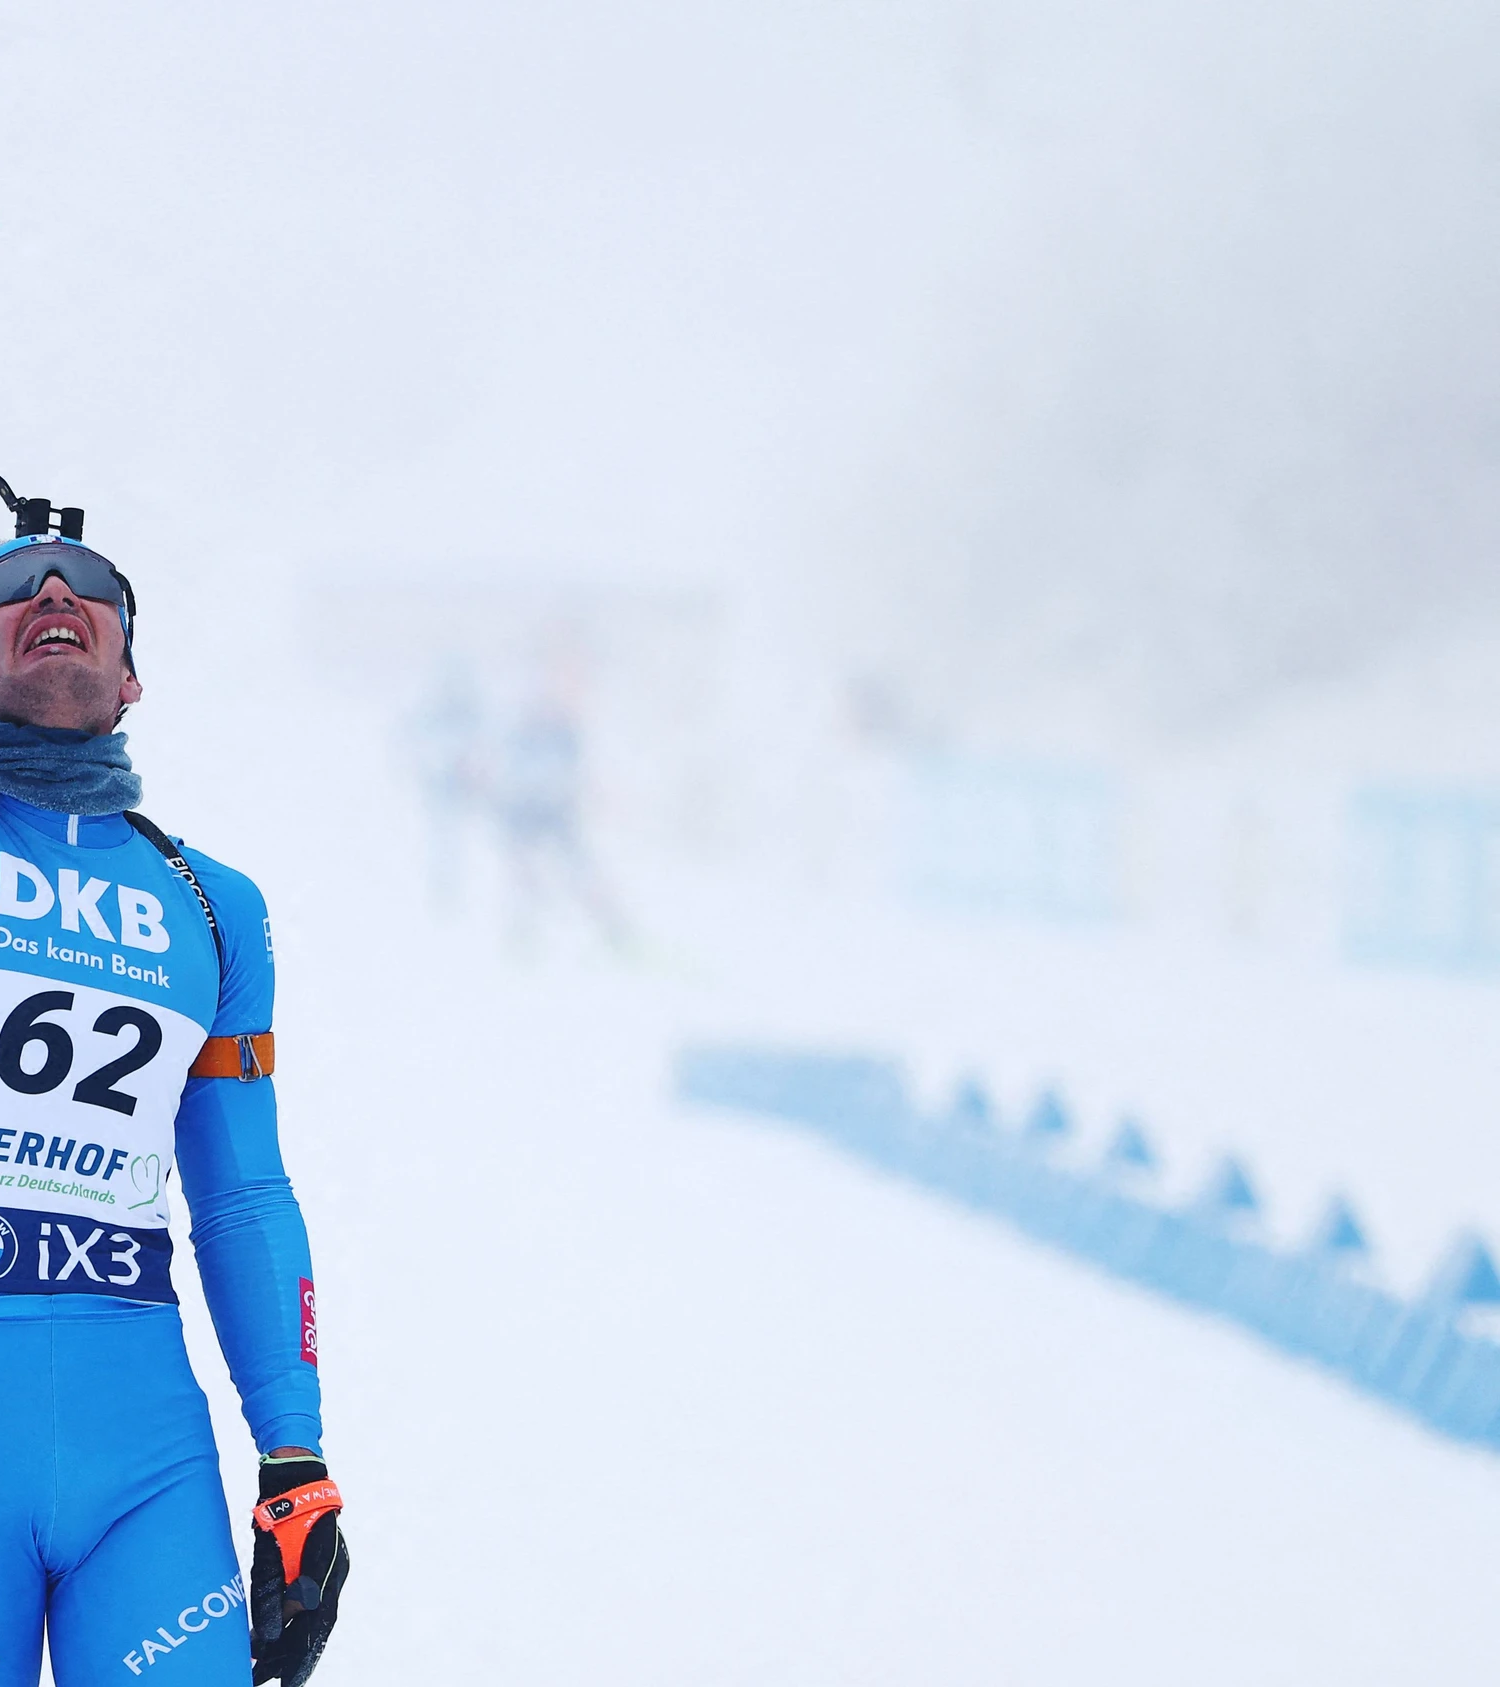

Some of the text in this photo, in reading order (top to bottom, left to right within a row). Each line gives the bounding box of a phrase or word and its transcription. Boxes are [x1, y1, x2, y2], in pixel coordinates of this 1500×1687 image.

[47, 936, 103, 970] kann
[111, 953, 171, 989] Bank
[17, 1174, 116, 1205] Deutschlands
[38, 1222, 141, 1286] iX3
